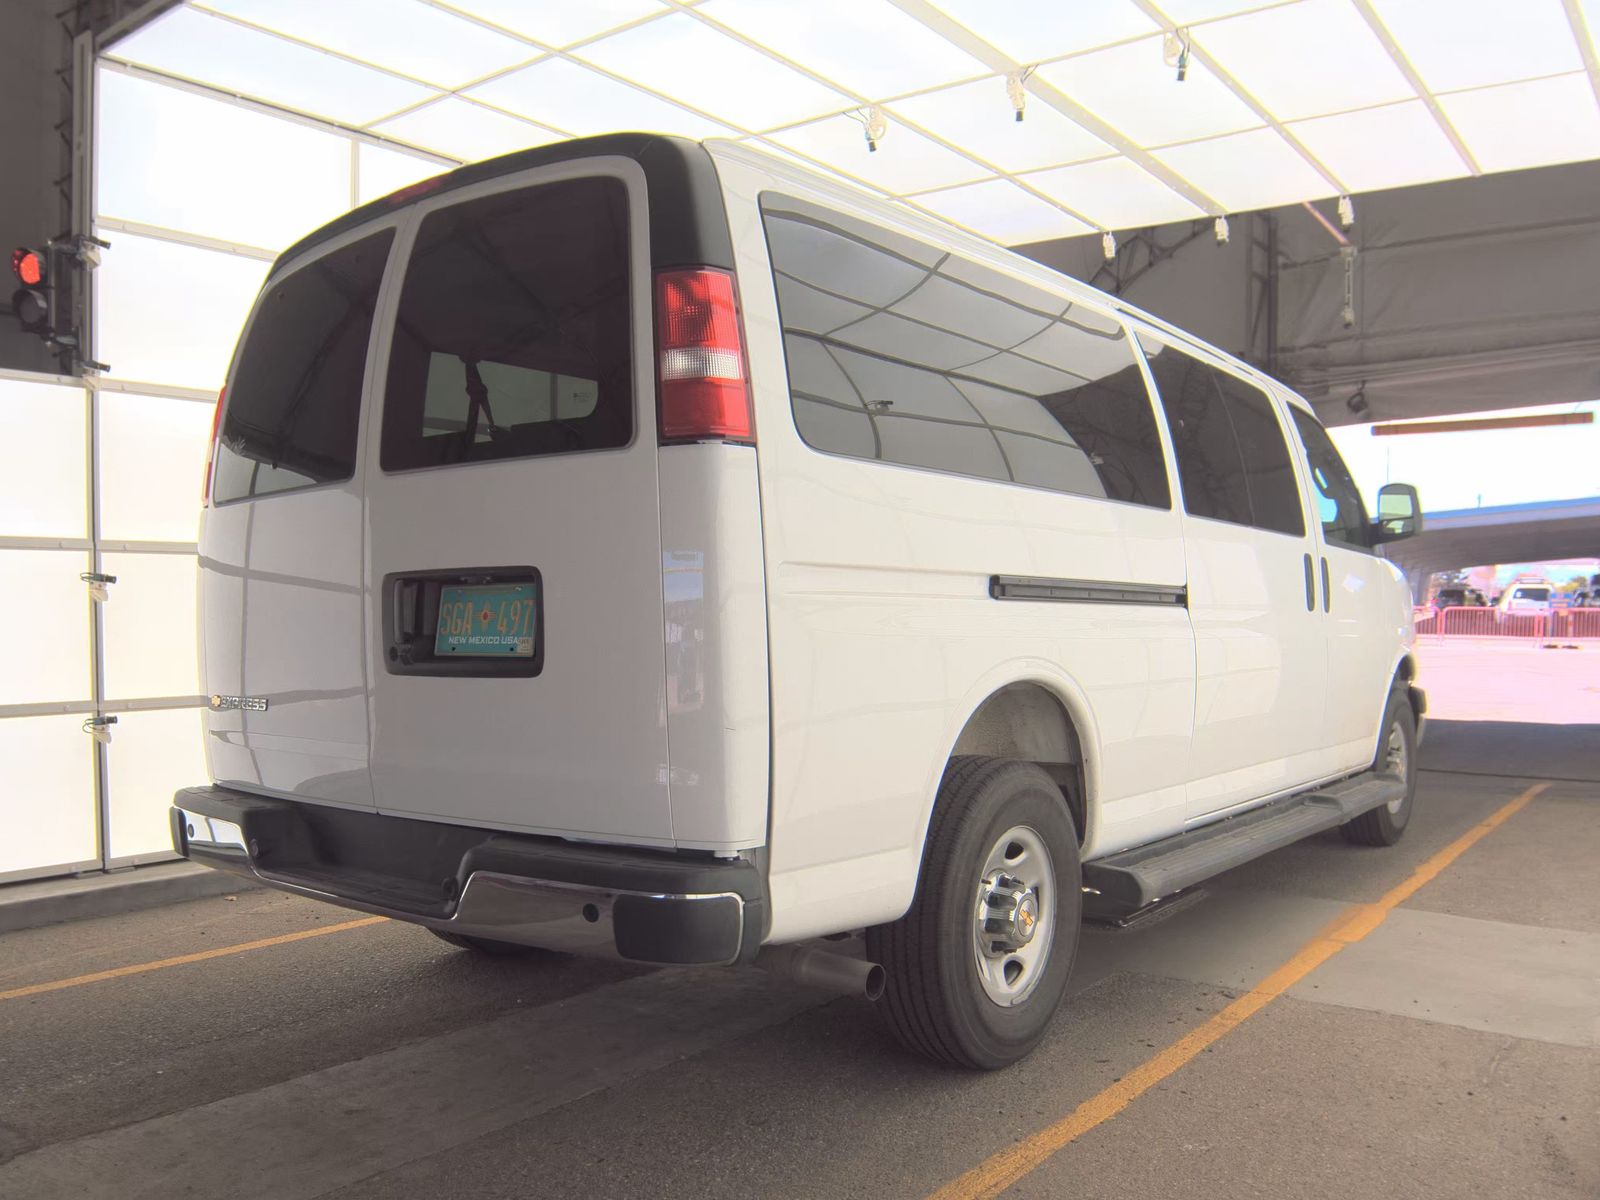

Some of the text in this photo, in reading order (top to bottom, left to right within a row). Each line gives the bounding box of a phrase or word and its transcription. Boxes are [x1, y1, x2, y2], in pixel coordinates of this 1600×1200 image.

[497, 600, 535, 634] 497
[448, 636, 466, 645] NEW
[468, 636, 500, 645] MEXICO
[501, 636, 519, 645] USA
[221, 696, 267, 711] EXPRESS
